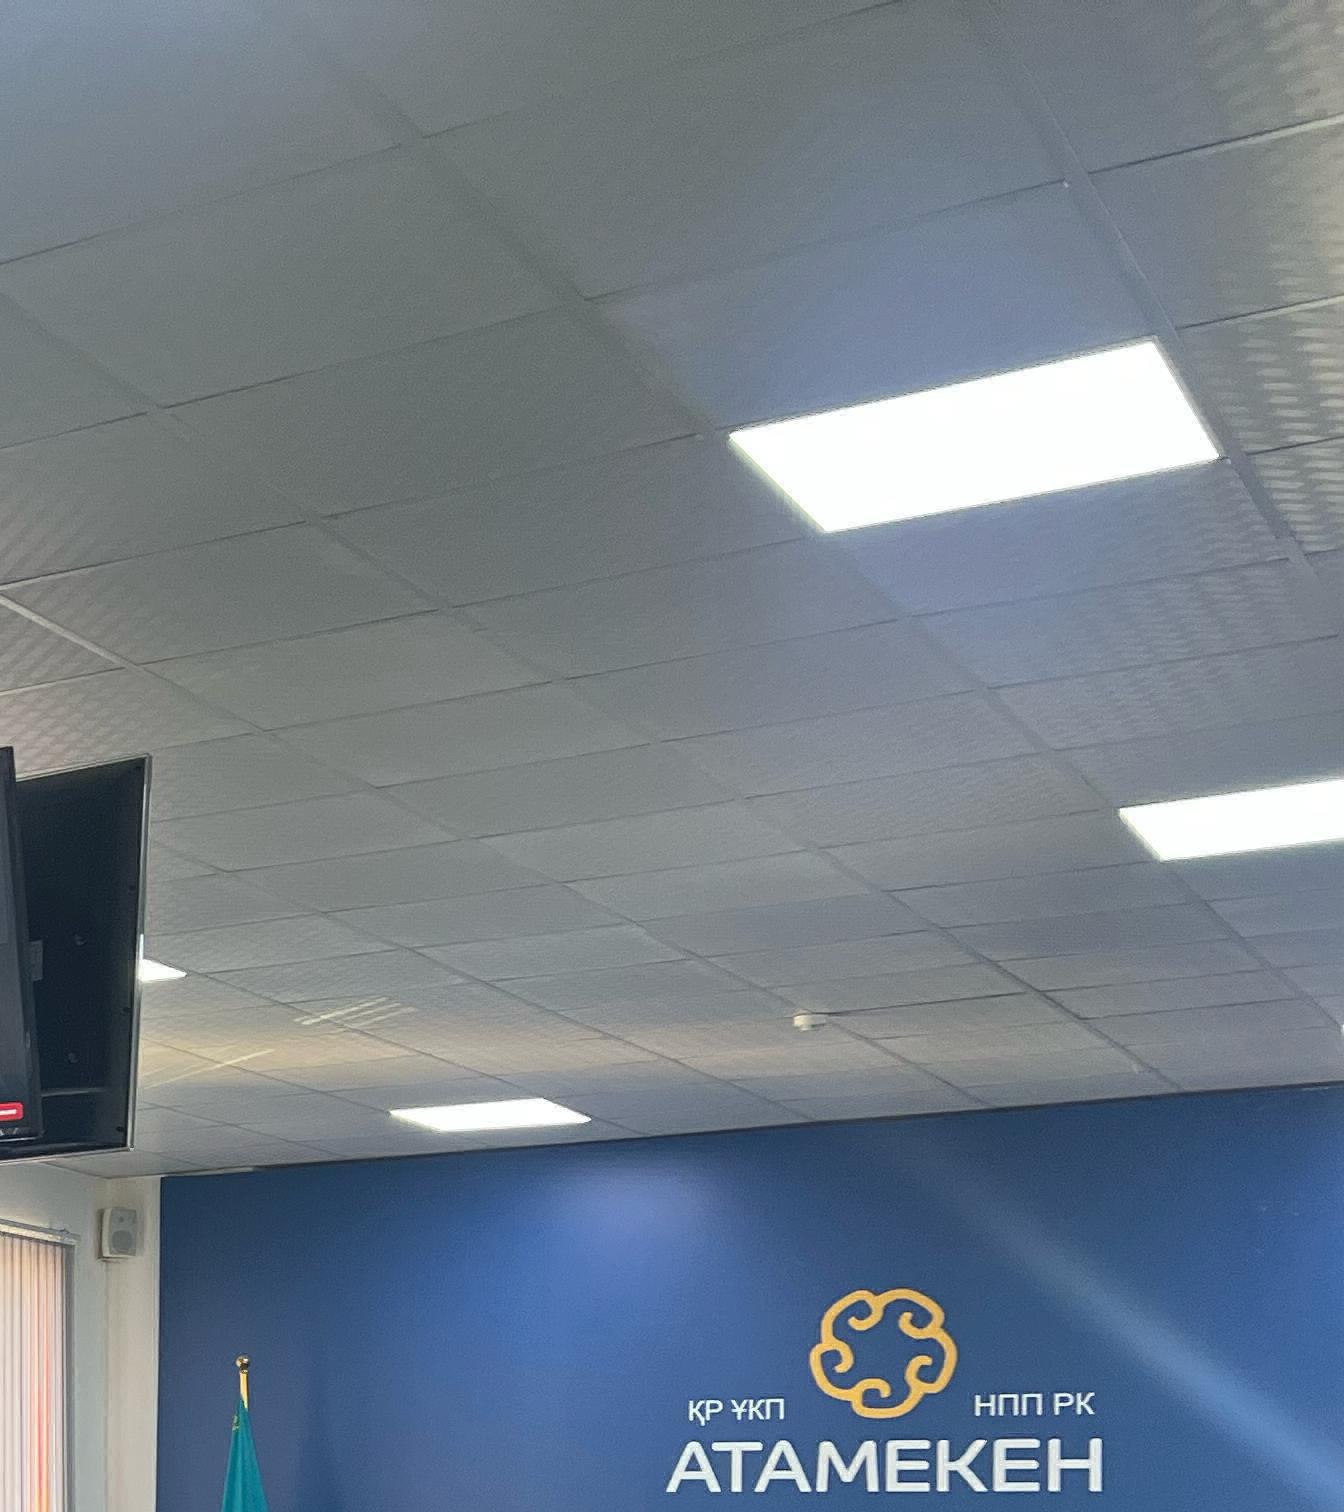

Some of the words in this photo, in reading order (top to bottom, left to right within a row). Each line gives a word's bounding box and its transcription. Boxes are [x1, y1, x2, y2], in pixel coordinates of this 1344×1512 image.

[688, 1399, 723, 1426] ҚР
[731, 1398, 785, 1421] ҰКП
[974, 1393, 1043, 1417] НПП
[1053, 1392, 1096, 1416] РК
[665, 1437, 1104, 1494] АТАМЕКЕН
